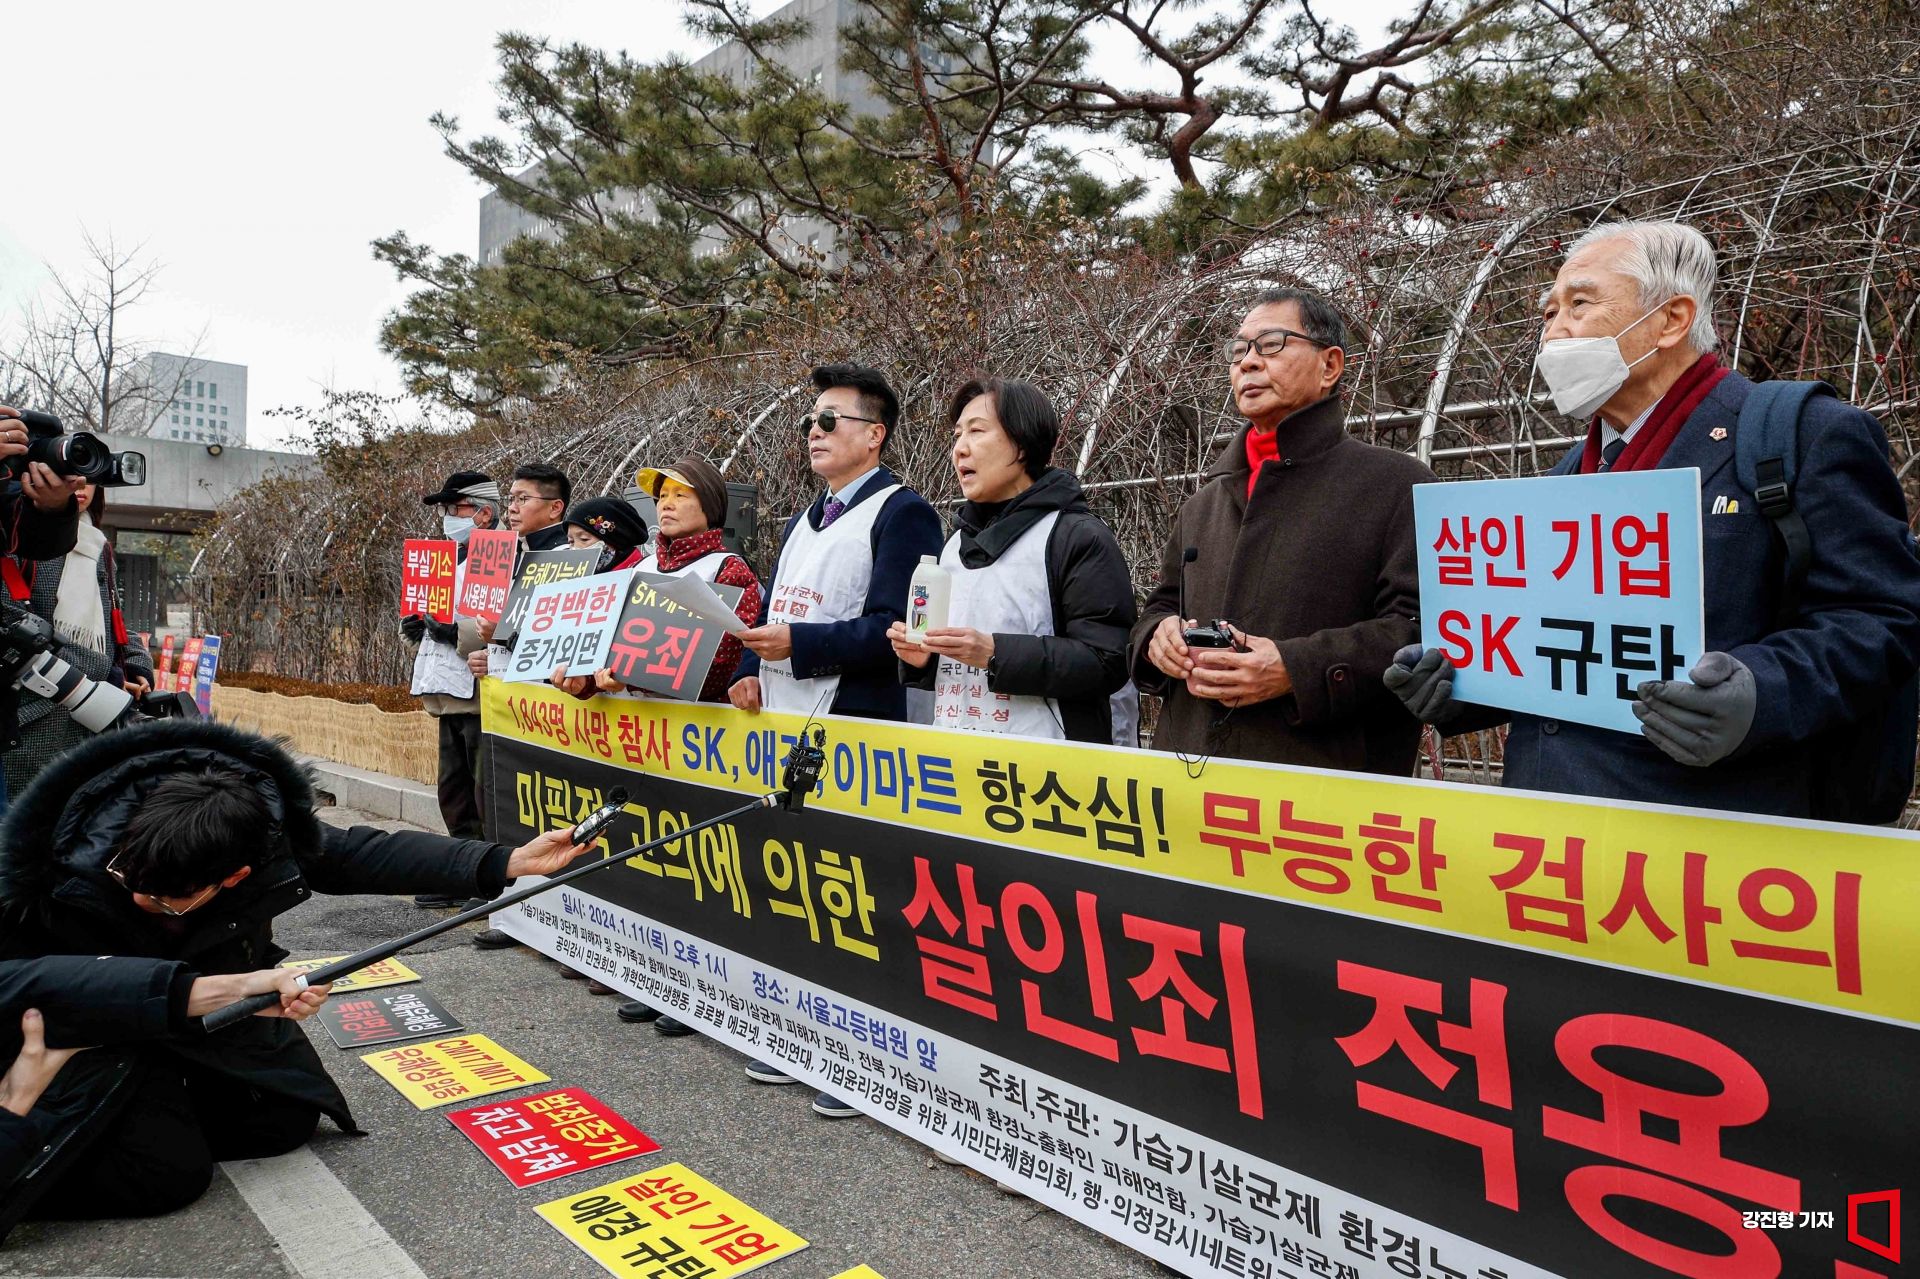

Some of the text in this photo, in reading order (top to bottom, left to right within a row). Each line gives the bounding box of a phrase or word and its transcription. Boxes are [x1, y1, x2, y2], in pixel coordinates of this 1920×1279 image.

[407, 550, 453, 579] 부실기소
[469, 538, 512, 579] 살인적
[1432, 512, 1671, 599] 살인 기업
[404, 584, 451, 616] 부실심리
[462, 583, 506, 614] 사용법 외면
[531, 583, 617, 632] 명백한
[515, 630, 604, 673] 증거외면
[610, 617, 704, 691] 유죄
[1437, 609, 1686, 702] SK 규탄
[507, 696, 571, 746] 1,843명
[575, 708, 613, 758] 사망
[617, 714, 672, 771] 참사
[976, 759, 1171, 858] 항소심!
[1199, 791, 1447, 914] 무능한
[1489, 832, 1864, 996] 검사의
[622, 802, 752, 919] 고의에
[762, 838, 880, 962] 의한
[901, 855, 1264, 1121] 살인죄
[434, 1039, 527, 1087] CMIT/MIT
[519, 901, 559, 930] 가습기살균제
[560, 918, 579, 939] 3단계
[580, 927, 602, 949] 피해자
[603, 937, 612, 954] 및
[614, 941, 647, 969] 유가족과
[696, 978, 717, 1001] 독성
[719, 988, 783, 1032] 가습기살균제
[784, 1018, 821, 1049] 피해자
[823, 1035, 855, 1064] 모임,
[857, 1049, 886, 1079] 전북
[889, 1064, 981, 1123] 가습기살균제
[985, 1107, 1095, 1174] 환경노출확인
[1101, 1157, 1195, 1219] 피해연합,
[555, 935, 585, 961] 공익감시
[585, 949, 618, 978] 민권회의,
[693, 999, 725, 1029] 글로벌
[727, 1014, 761, 1047] 에코넷,
[766, 1031, 815, 1073] 국민연대,
[819, 1057, 913, 1118] 기업윤리경영을
[917, 1102, 948, 1135] 위한
[951, 1120, 1077, 1201] 시민단체협의회,
[561, 892, 586, 919] 일시:
[588, 904, 668, 956] 2024.1.11(목)
[673, 939, 700, 969] 오후
[705, 953, 728, 982] 1시
[752, 970, 789, 1005] 장소:
[796, 990, 909, 1060] 서울고등법원
[916, 1038, 938, 1072] 앞
[1113, 1118, 1322, 1239] 가습기살균제
[469, 1106, 578, 1177] 차고 넘쳐
[522, 1092, 640, 1161] 범죄증거
[569, 1194, 652, 1241] 애경
[622, 1175, 781, 1266] 살인 기업
